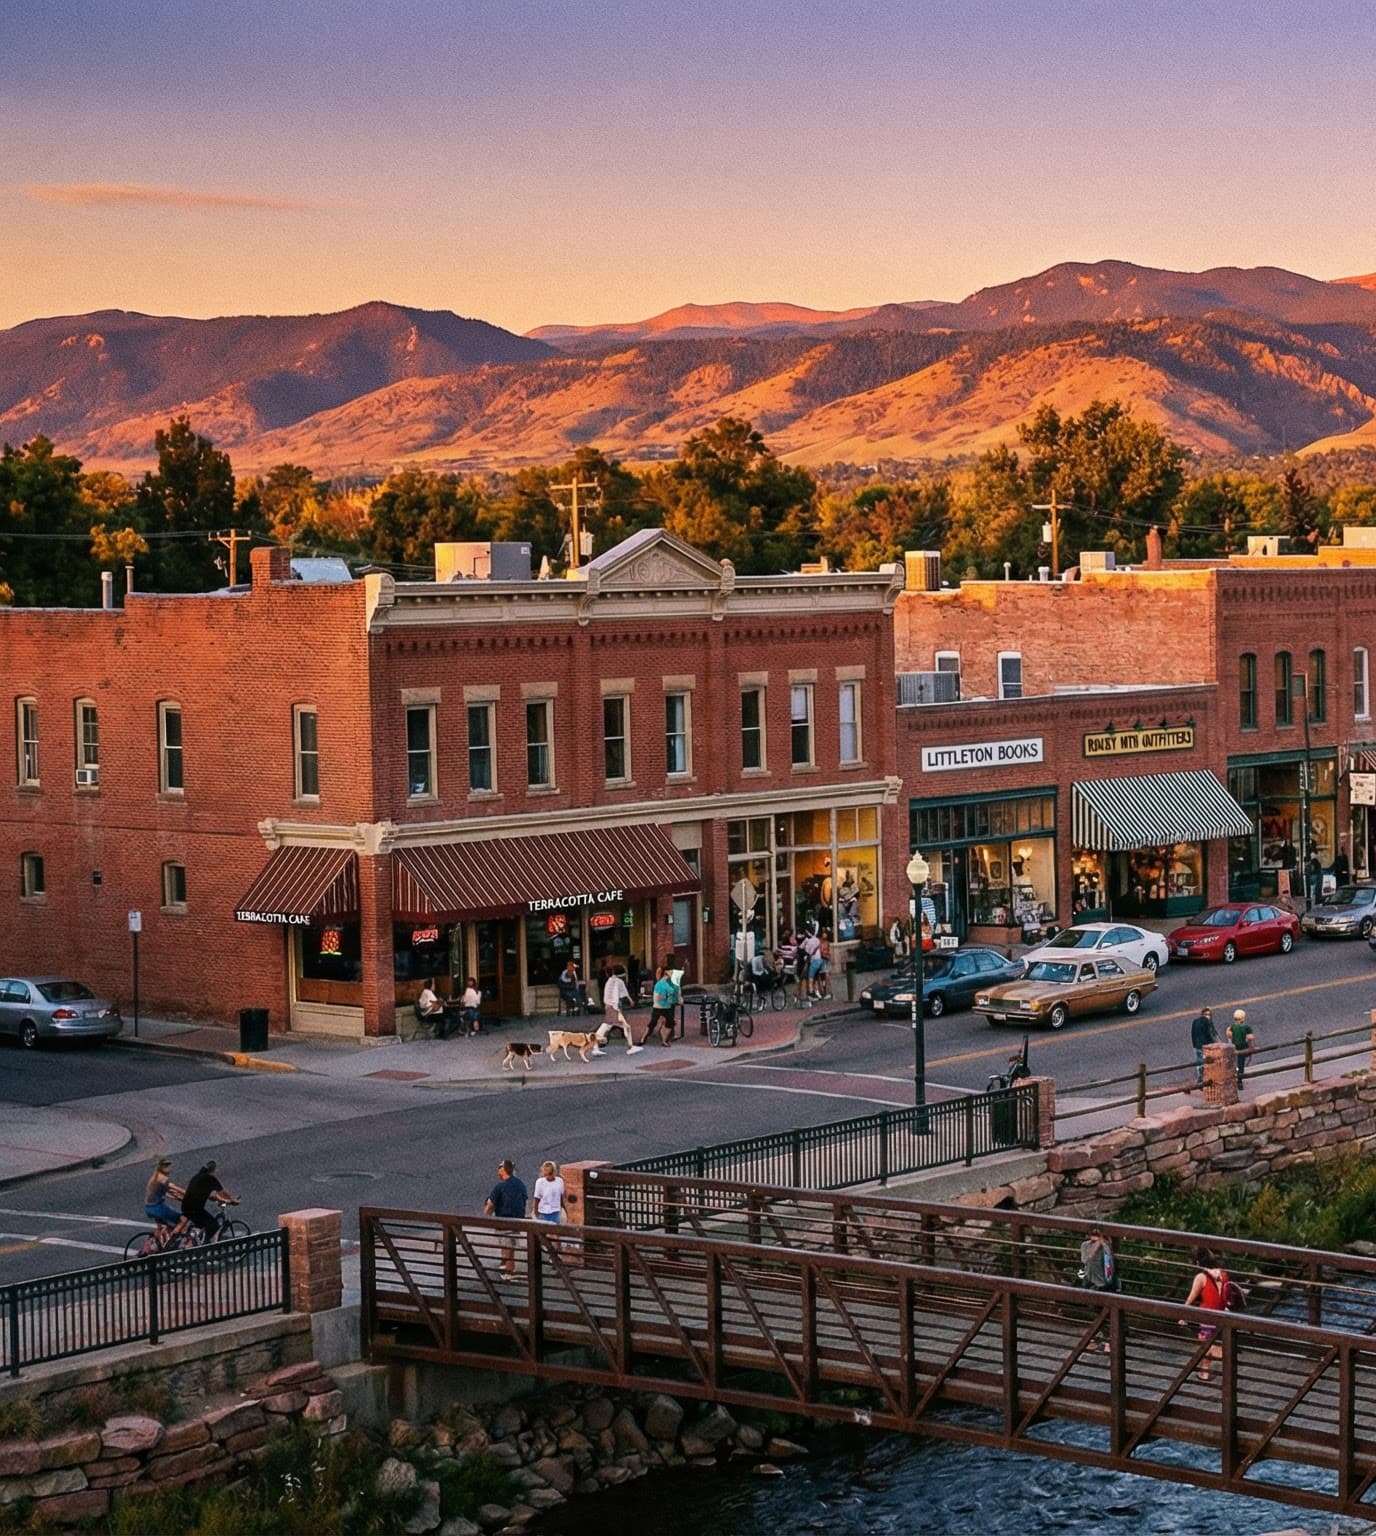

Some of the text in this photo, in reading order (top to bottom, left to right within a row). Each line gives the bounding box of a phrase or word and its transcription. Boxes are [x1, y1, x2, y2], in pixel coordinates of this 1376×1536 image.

[927, 743, 1039, 767] LITTLETON BOOKS
[528, 889, 624, 912] TERRACOTTA CAFE
